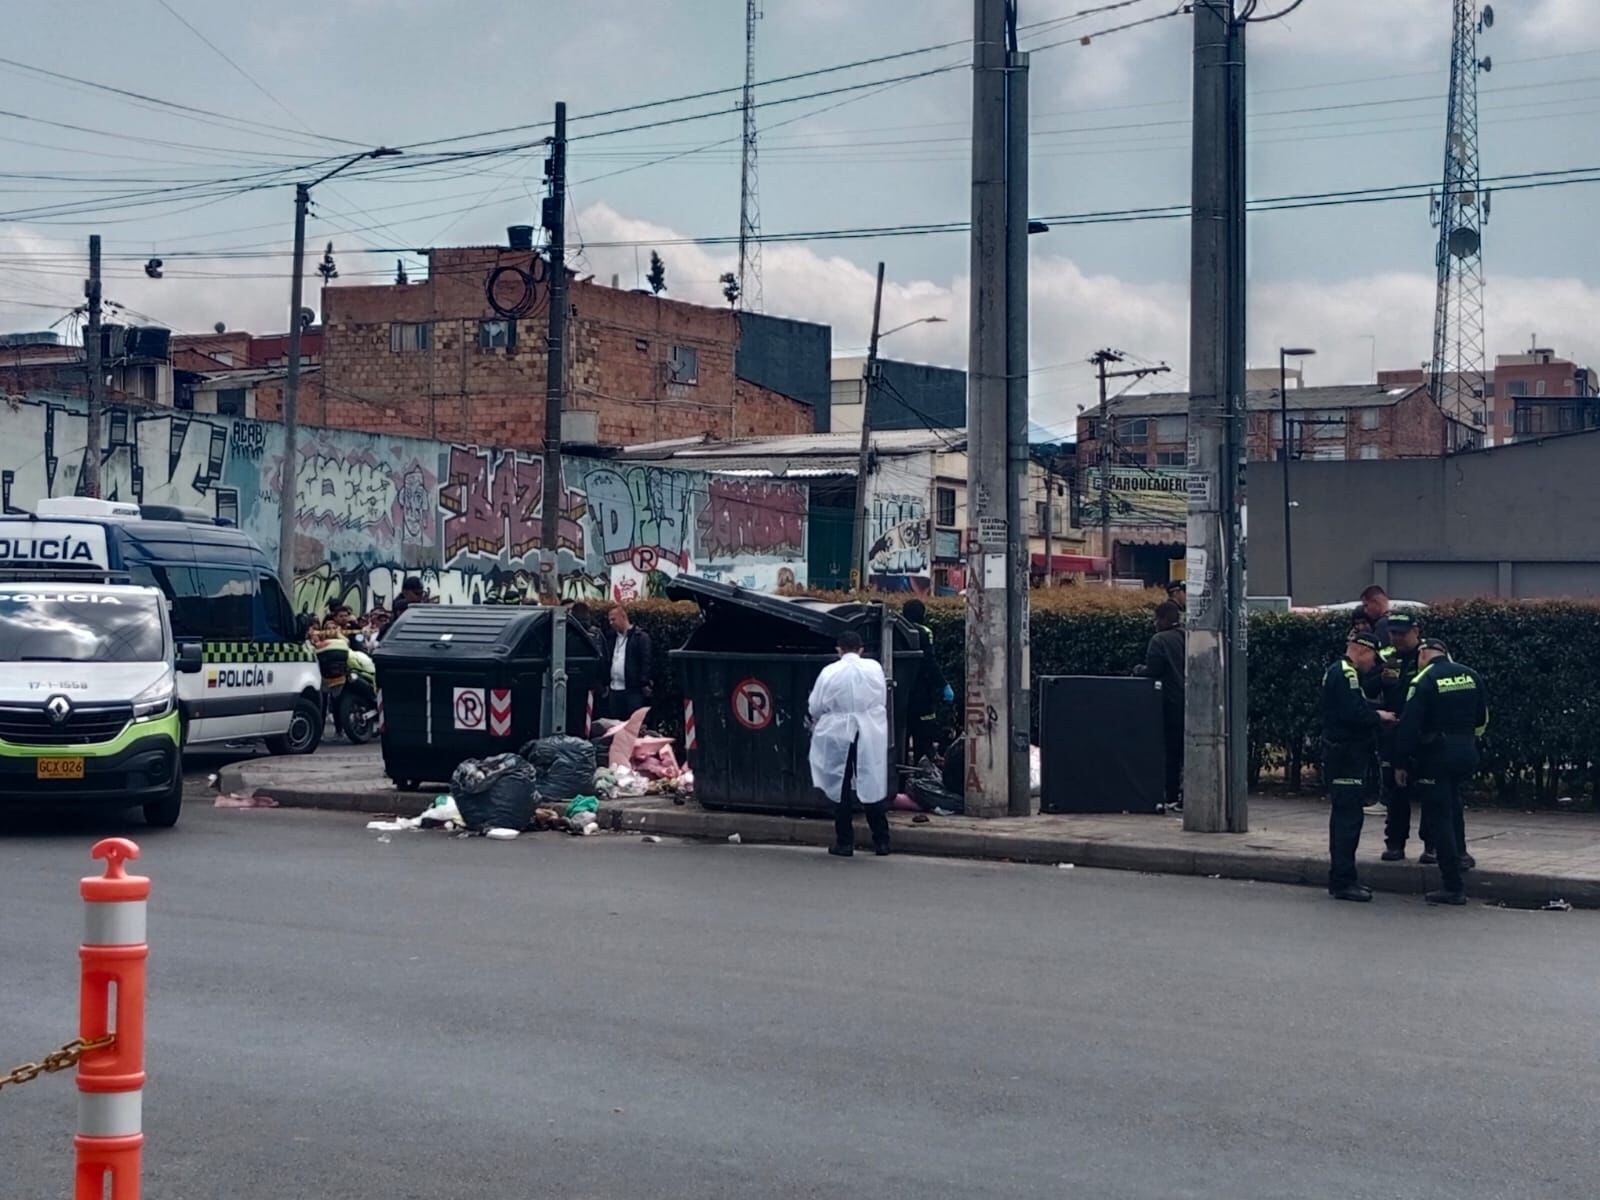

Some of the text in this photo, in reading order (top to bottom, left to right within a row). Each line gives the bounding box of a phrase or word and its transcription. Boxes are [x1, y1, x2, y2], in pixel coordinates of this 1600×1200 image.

[233, 421, 263, 445] ACAB
[218, 664, 265, 688] POLICÍA
[1436, 673, 1474, 686] POLICÍA
[39, 761, 82, 773] GCX 026
